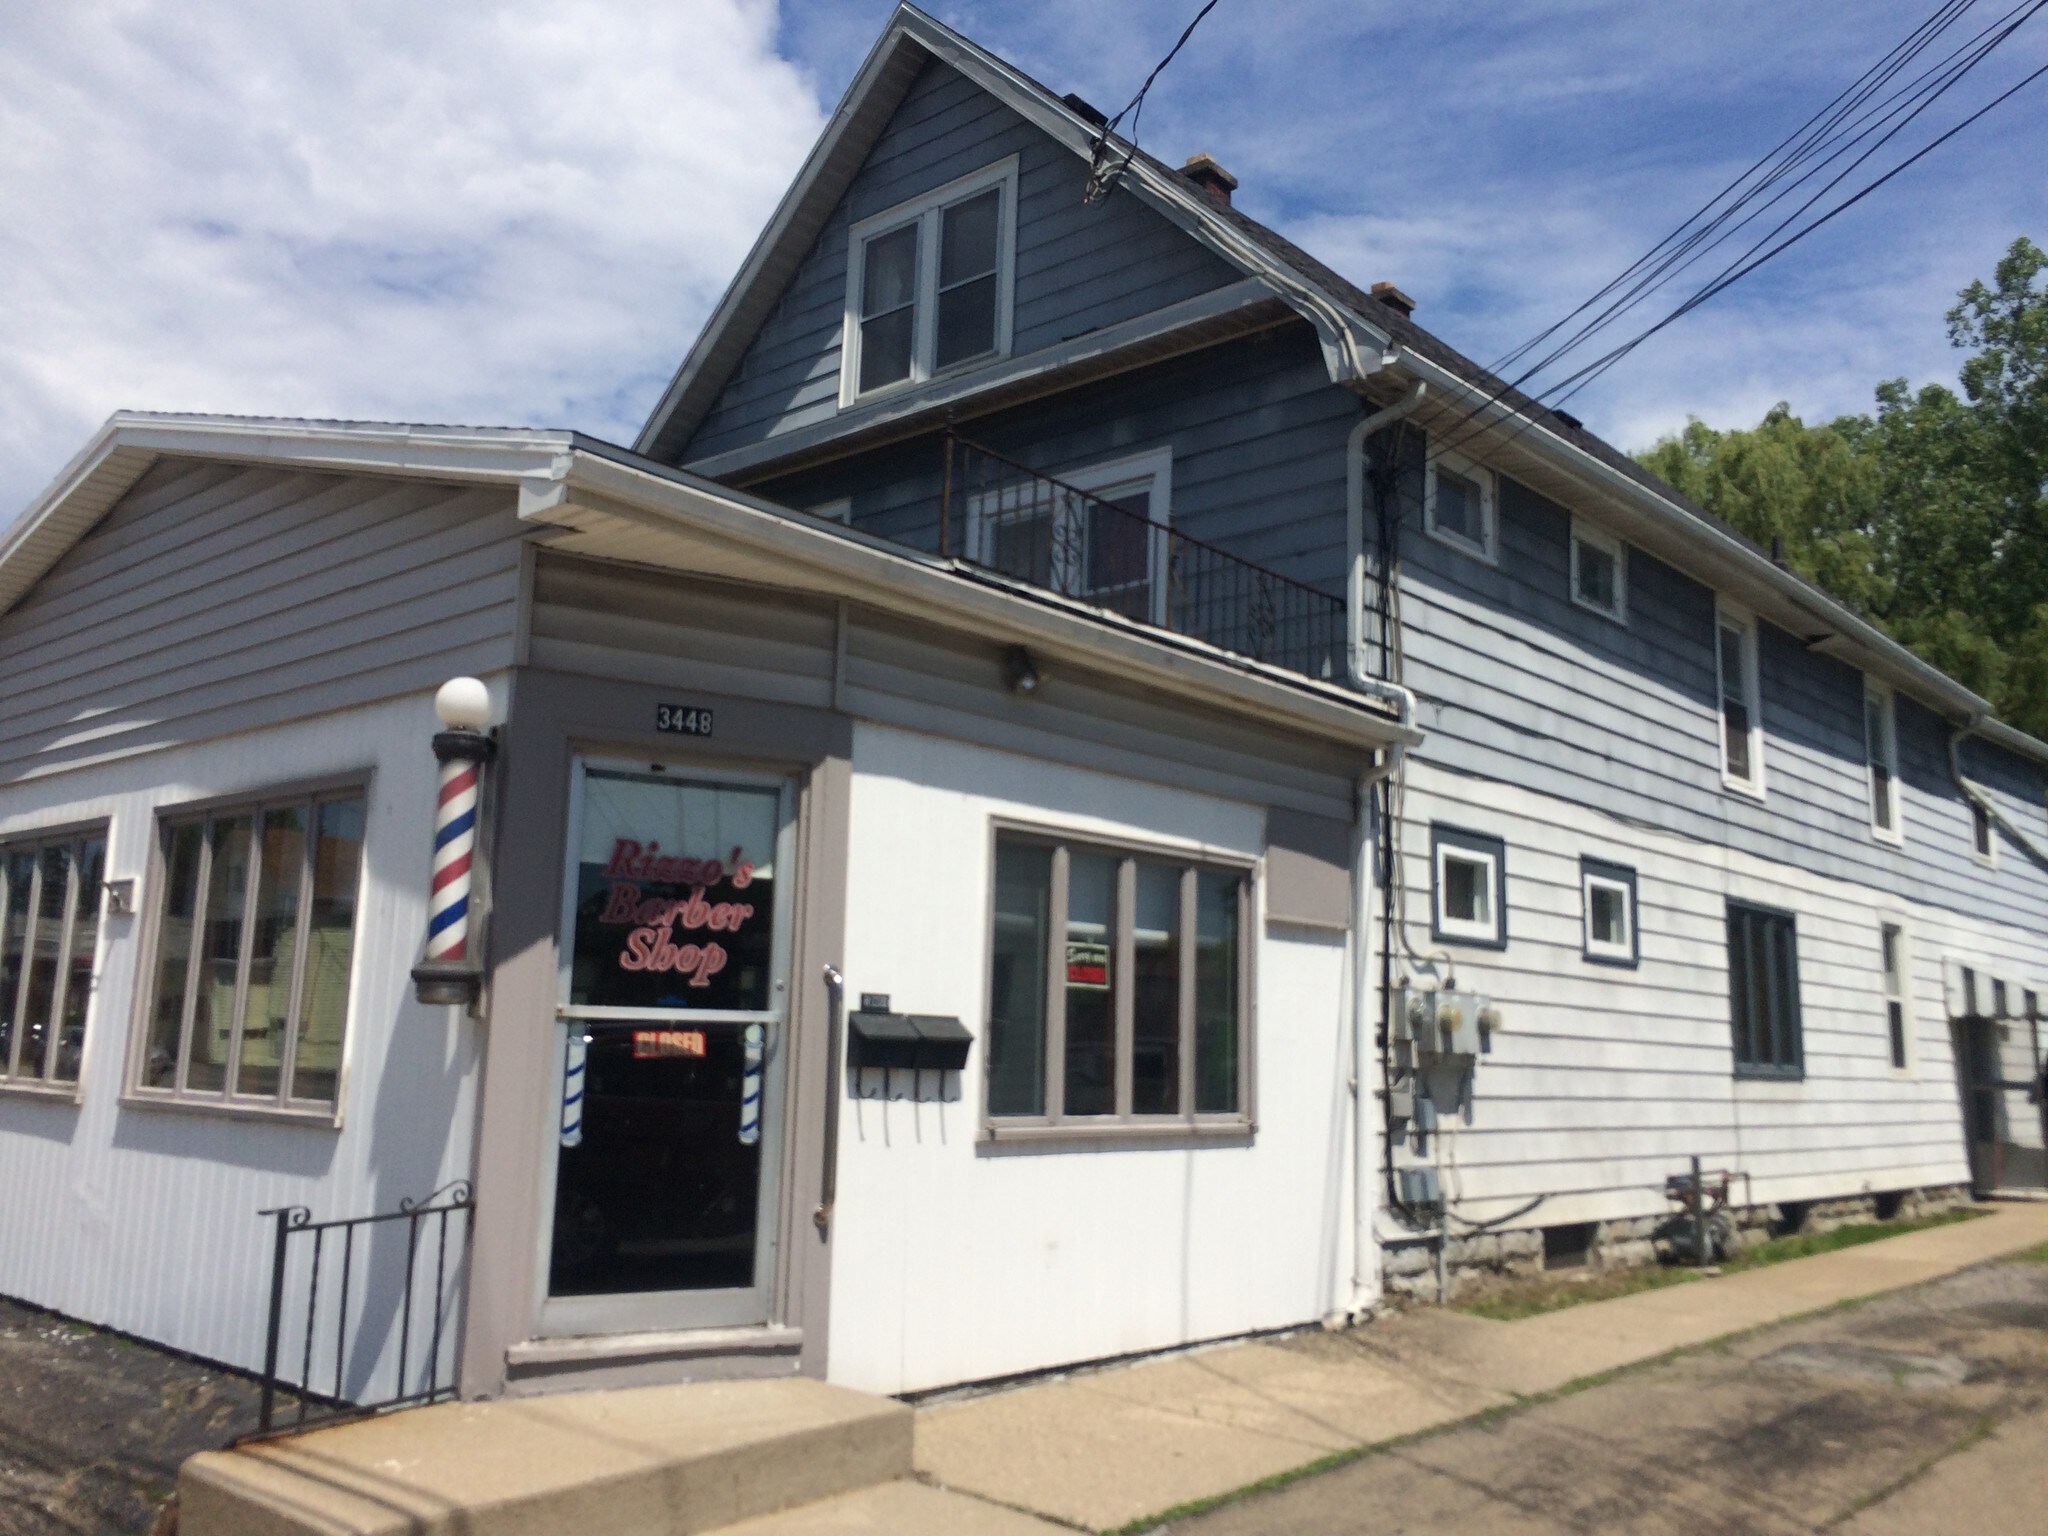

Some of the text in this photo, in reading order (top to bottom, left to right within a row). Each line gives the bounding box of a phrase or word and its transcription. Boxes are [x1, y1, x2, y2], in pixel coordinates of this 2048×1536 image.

[659, 706, 712, 734] 3448
[602, 838, 756, 889] Rizzo's
[599, 882, 755, 932] Barber
[619, 927, 728, 988] Shop
